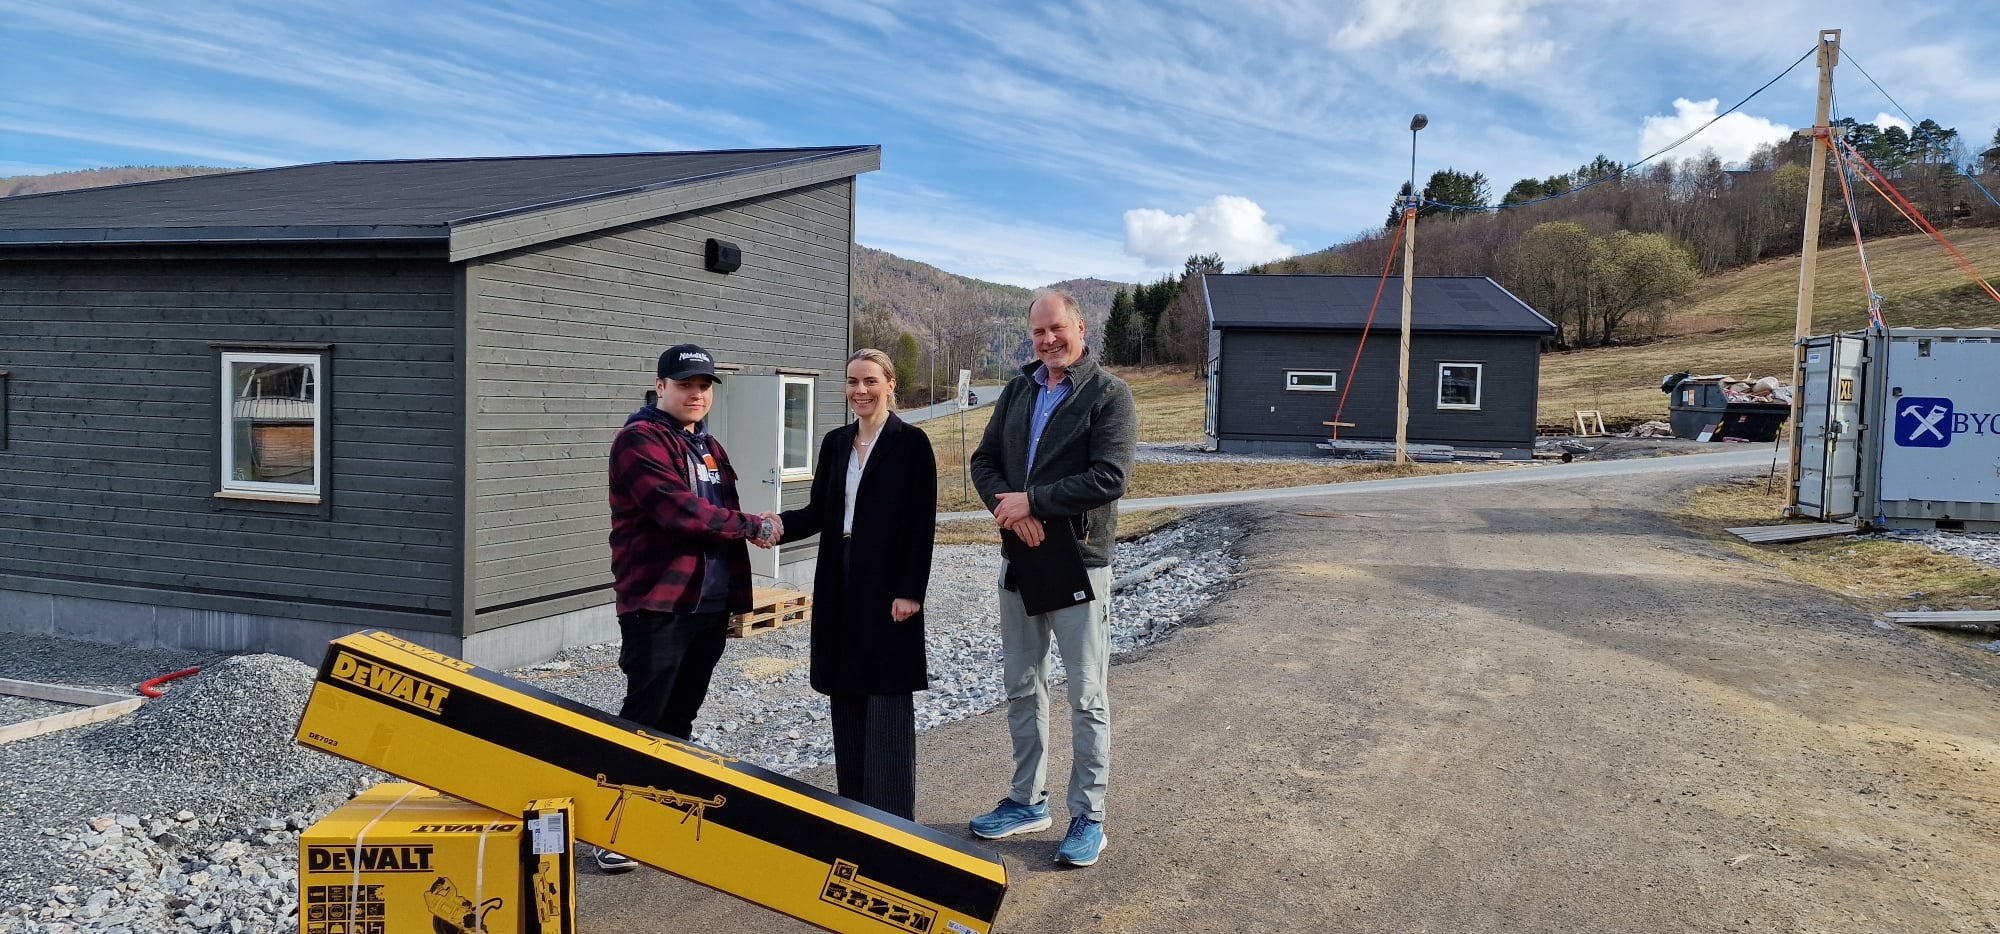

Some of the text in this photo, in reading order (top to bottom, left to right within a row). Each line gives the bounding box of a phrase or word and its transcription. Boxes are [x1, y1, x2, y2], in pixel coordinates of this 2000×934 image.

[1840, 380, 1853, 400] XL
[331, 653, 451, 712] DEWALT
[308, 731, 339, 747] DE7023
[308, 848, 434, 870] DEWALT
